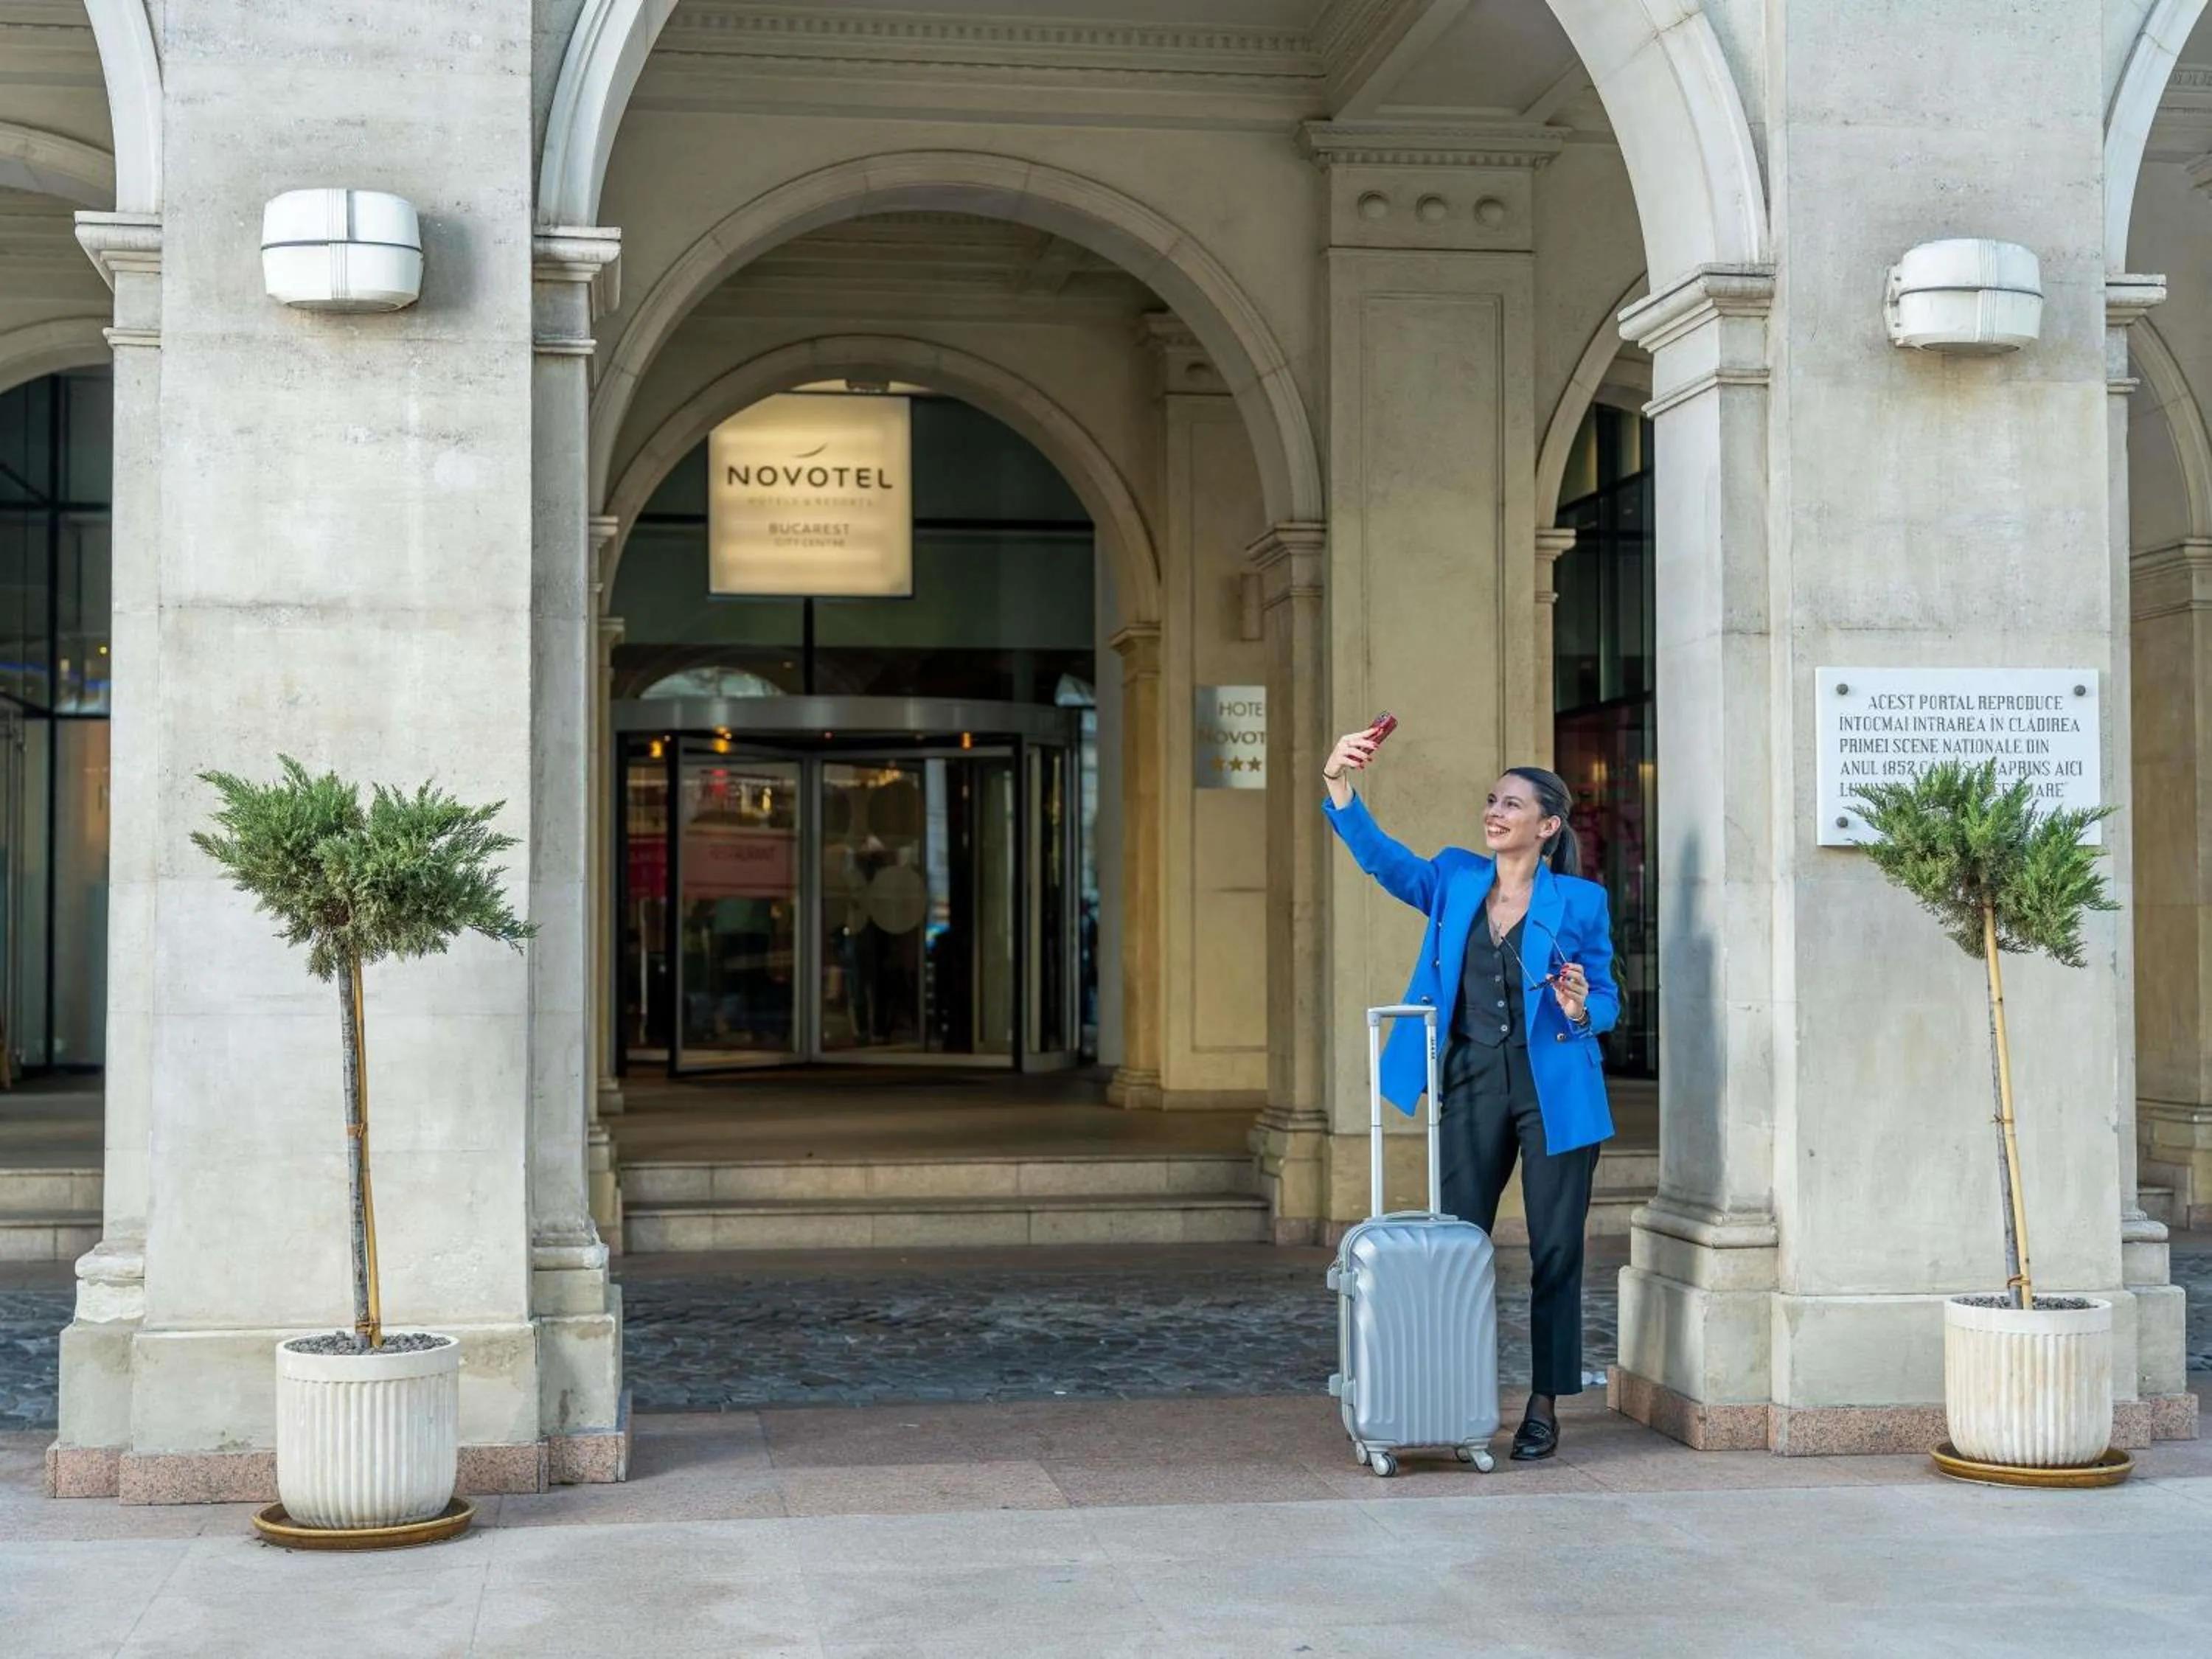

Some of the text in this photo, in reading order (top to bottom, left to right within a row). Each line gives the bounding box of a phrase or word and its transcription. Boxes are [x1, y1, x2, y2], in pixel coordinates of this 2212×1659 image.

[726, 465, 894, 490] NOVOTEL
[768, 523, 849, 536] BUCAREST
[1868, 695, 2063, 710] ACEST PORTAL REPRODUCE
[1913, 717, 1986, 732] INTRAREA
[1840, 738, 1888, 754] PRIMEI
[1893, 739, 1938, 754] SCENE
[2026, 739, 2049, 754] DIN
[1840, 760, 1879, 776] ANUL
[1998, 760, 2051, 776] APRINS
[2055, 760, 2082, 776] AICI
